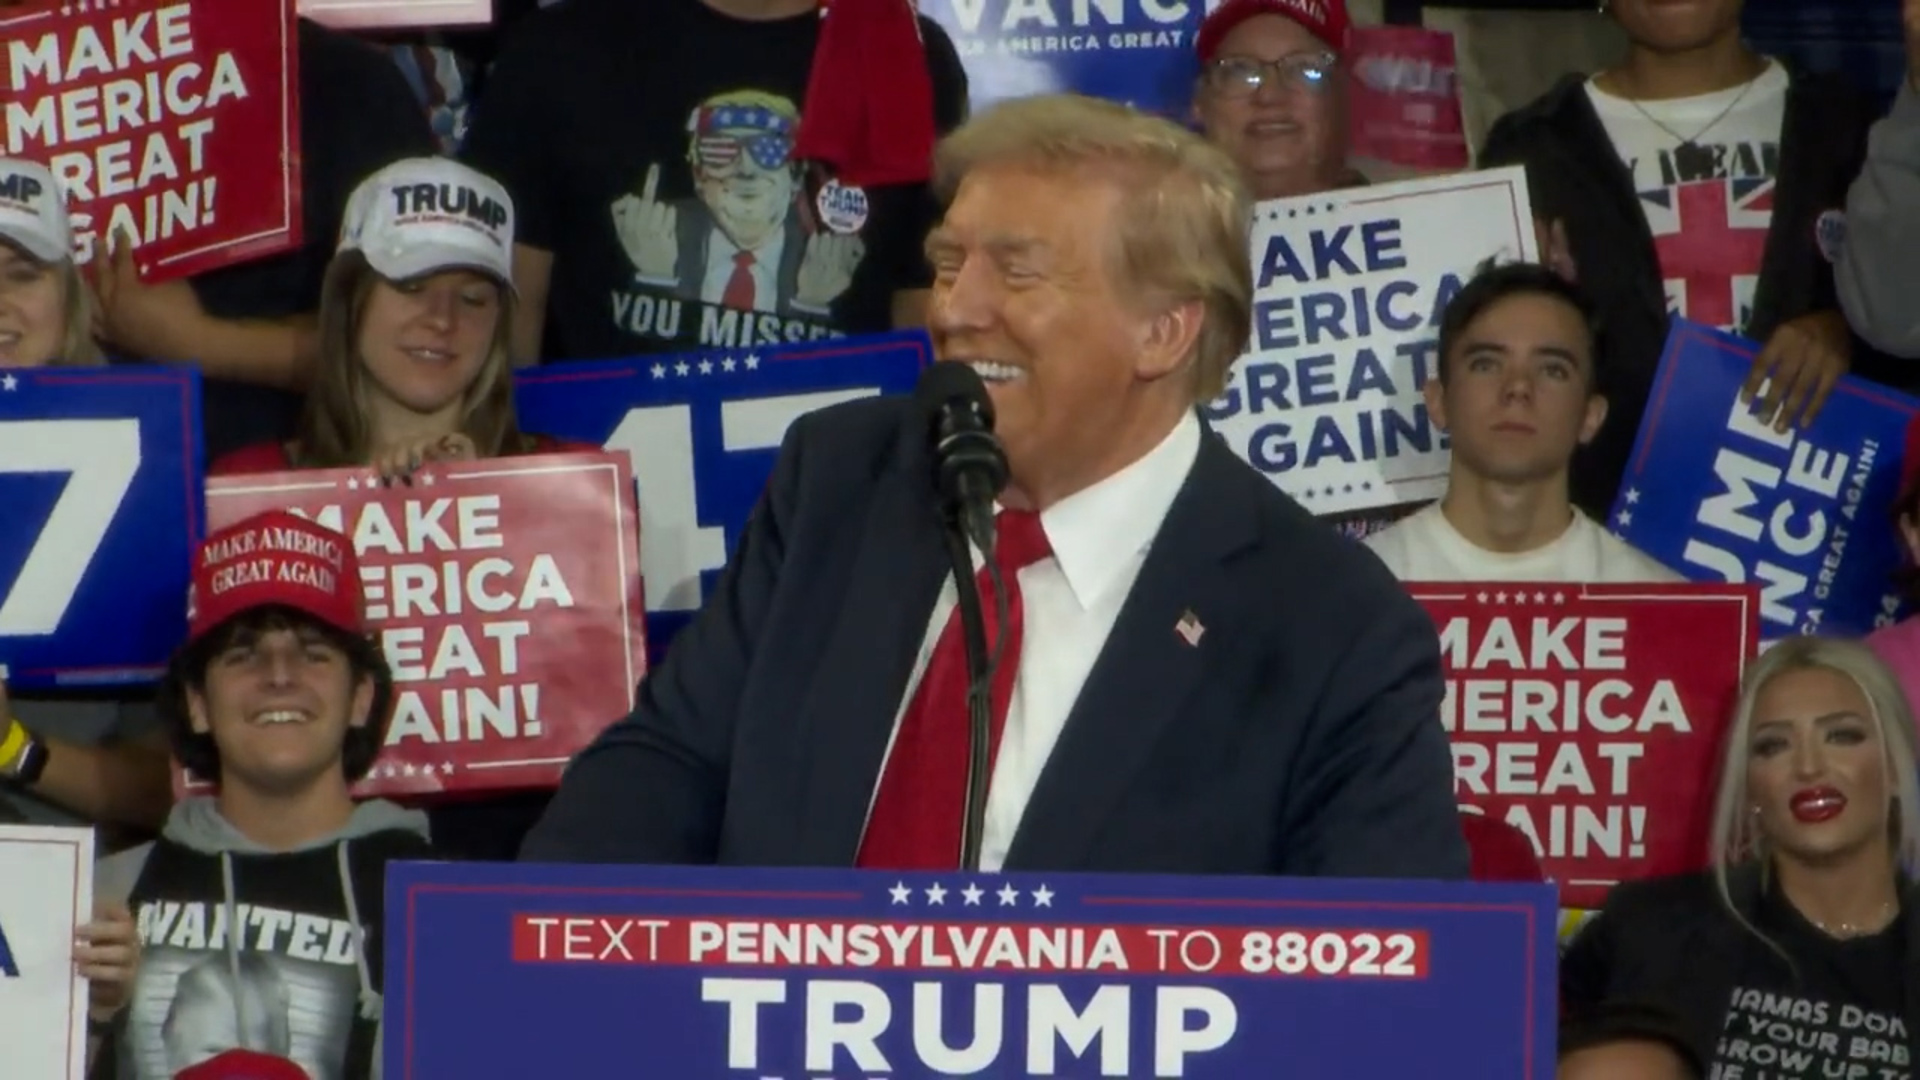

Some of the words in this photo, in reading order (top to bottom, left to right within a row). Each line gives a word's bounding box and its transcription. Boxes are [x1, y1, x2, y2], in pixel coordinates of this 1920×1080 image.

[8, 3, 194, 92] MAKE
[1108, 31, 1183, 49] GREAT
[3, 52, 249, 154] MERICA
[50, 118, 214, 202] REAT
[67, 177, 217, 265] GAIN!
[391, 182, 508, 230] TRUMP
[1256, 218, 1408, 290] AKE
[611, 290, 682, 339] YOU
[1253, 273, 1466, 351] ERICA
[0, 417, 141, 636] 7
[203, 529, 257, 568] MAKE
[211, 558, 275, 596] GREAT
[359, 553, 575, 621] ERICA
[1814, 527, 1850, 600] GREAT
[381, 620, 531, 682] EAT
[384, 683, 543, 746] AIN!
[1440, 679, 1692, 732] ERICA
[1450, 742, 1645, 795] REAT
[1457, 804, 1647, 858] AIN!
[136, 899, 366, 965] WANTED
[527, 917, 670, 961] TEXT
[689, 920, 1129, 971] PENNSYLVANIA
[1146, 929, 1221, 973] TO
[1240, 931, 1416, 976] 88022
[701, 977, 1238, 1078] TRUMP
[1747, 1014, 1840, 1055] YOUR
